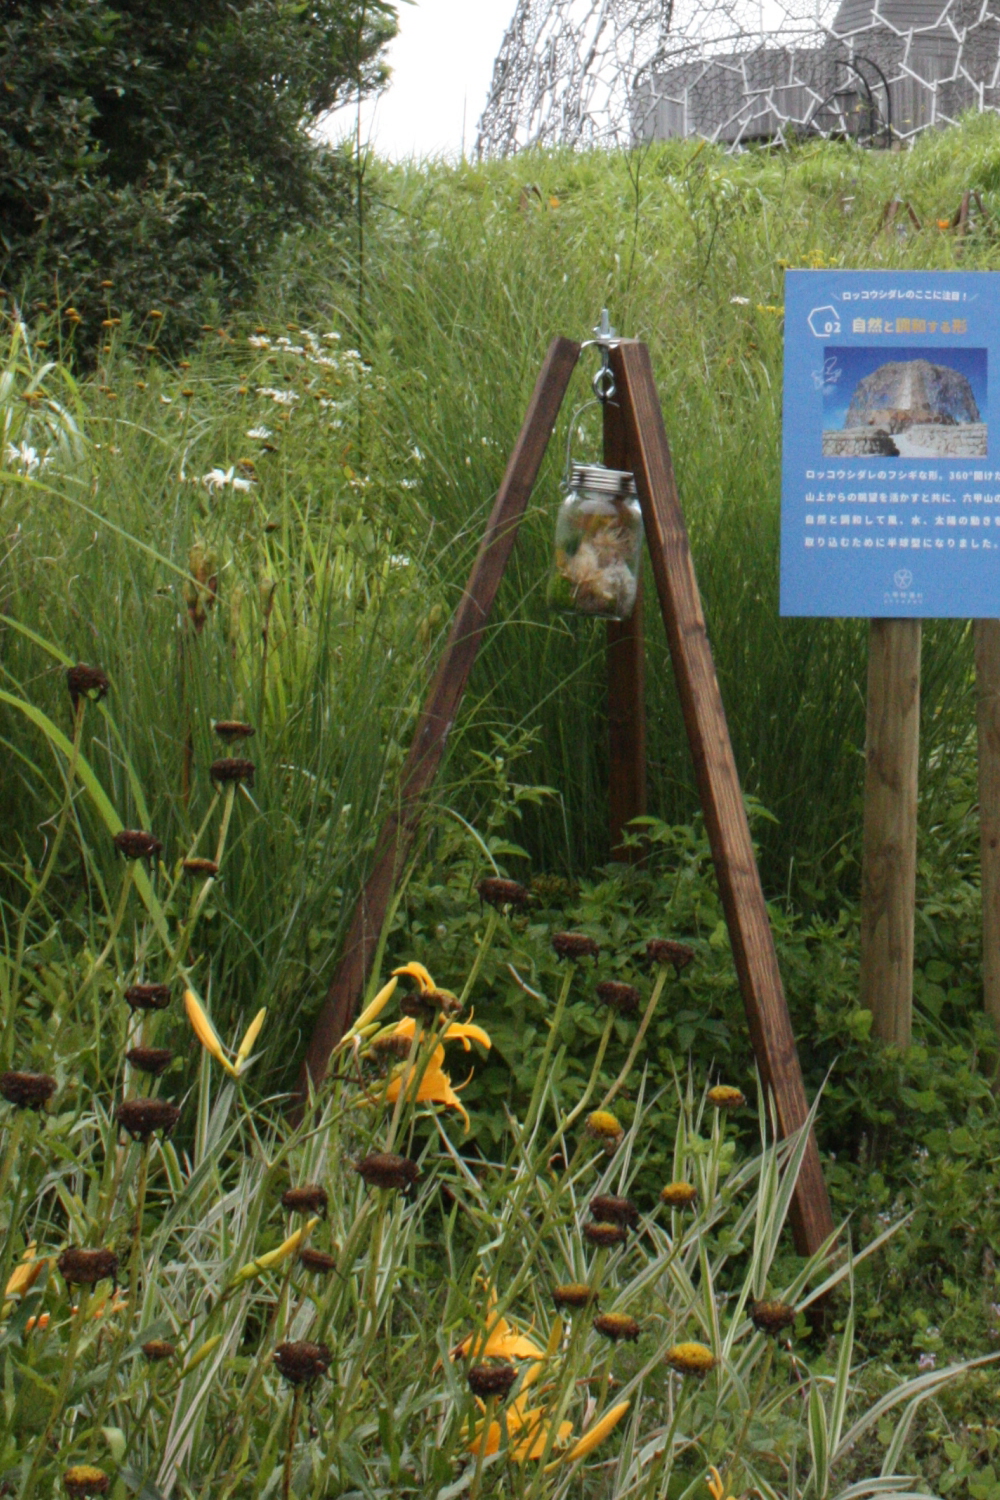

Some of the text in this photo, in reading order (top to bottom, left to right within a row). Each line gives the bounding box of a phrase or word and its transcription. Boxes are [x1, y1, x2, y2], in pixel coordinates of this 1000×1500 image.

[824, 317, 967, 334] 02 自然と調和する形
